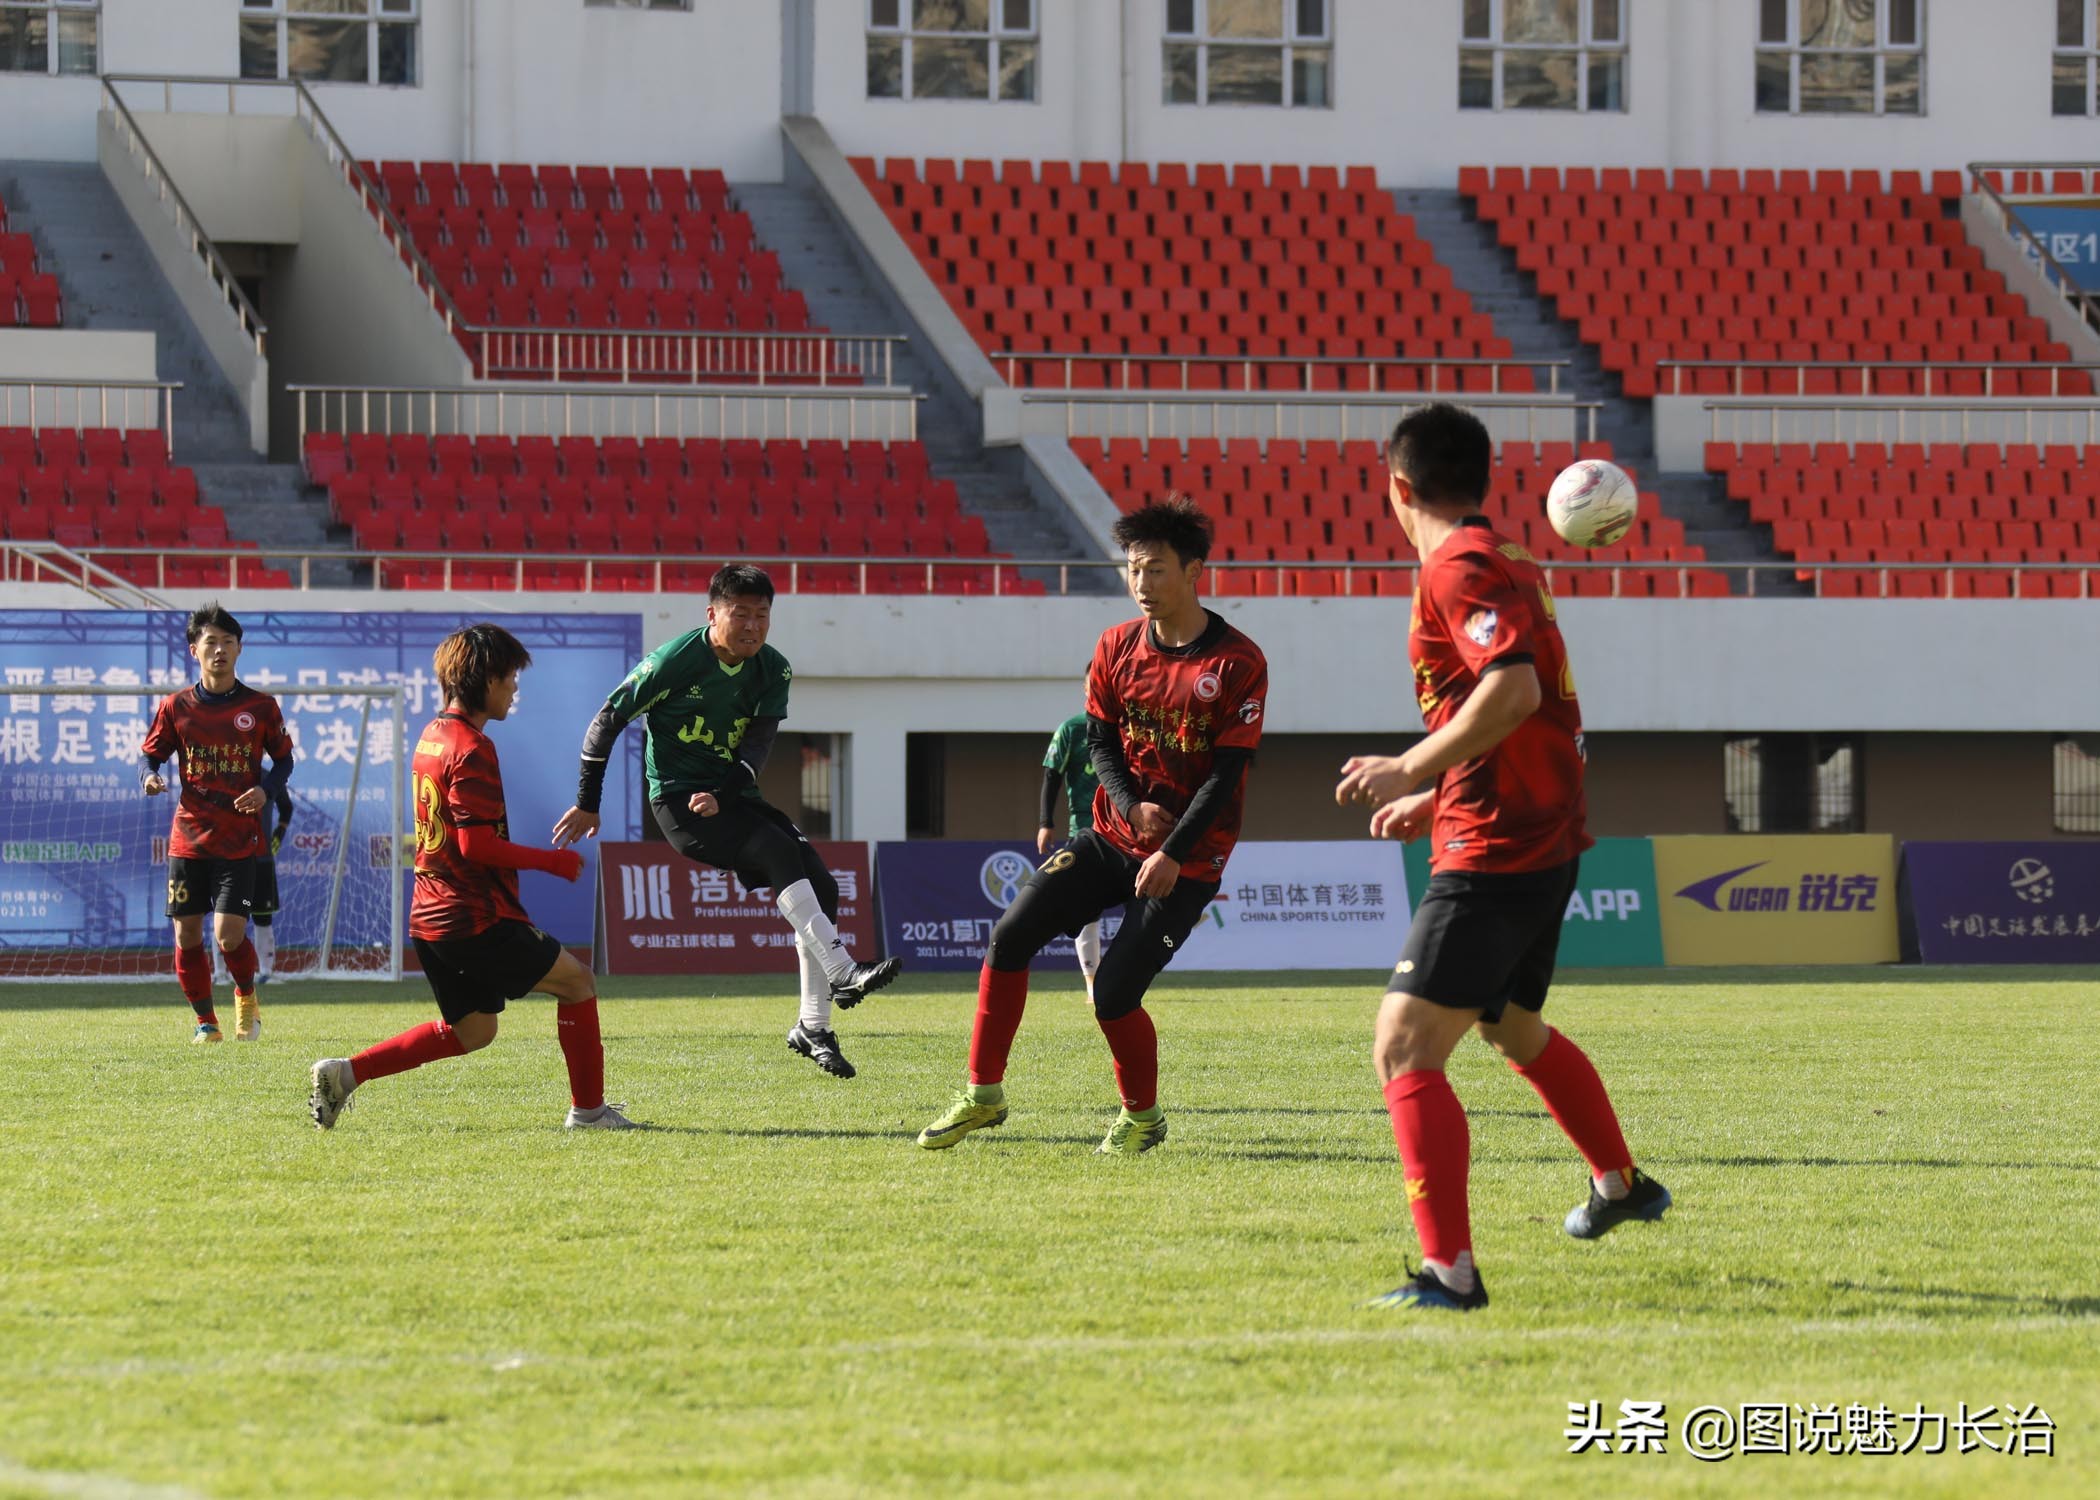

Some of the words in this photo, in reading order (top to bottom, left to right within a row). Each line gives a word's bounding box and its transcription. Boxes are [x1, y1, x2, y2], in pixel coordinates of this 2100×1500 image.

[1237, 884, 1384, 908] 中国体育彩票
[1798, 874, 1880, 912] 锐克
[694, 907, 768, 918] Professional
[1240, 911, 1277, 922] CHINA
[1281, 911, 1329, 922] SPORTS
[1332, 911, 1385, 922] LOTTERY
[629, 934, 736, 949] 专业足球装备
[917, 946, 938, 957] 2021
[941, 947, 965, 957] Love
